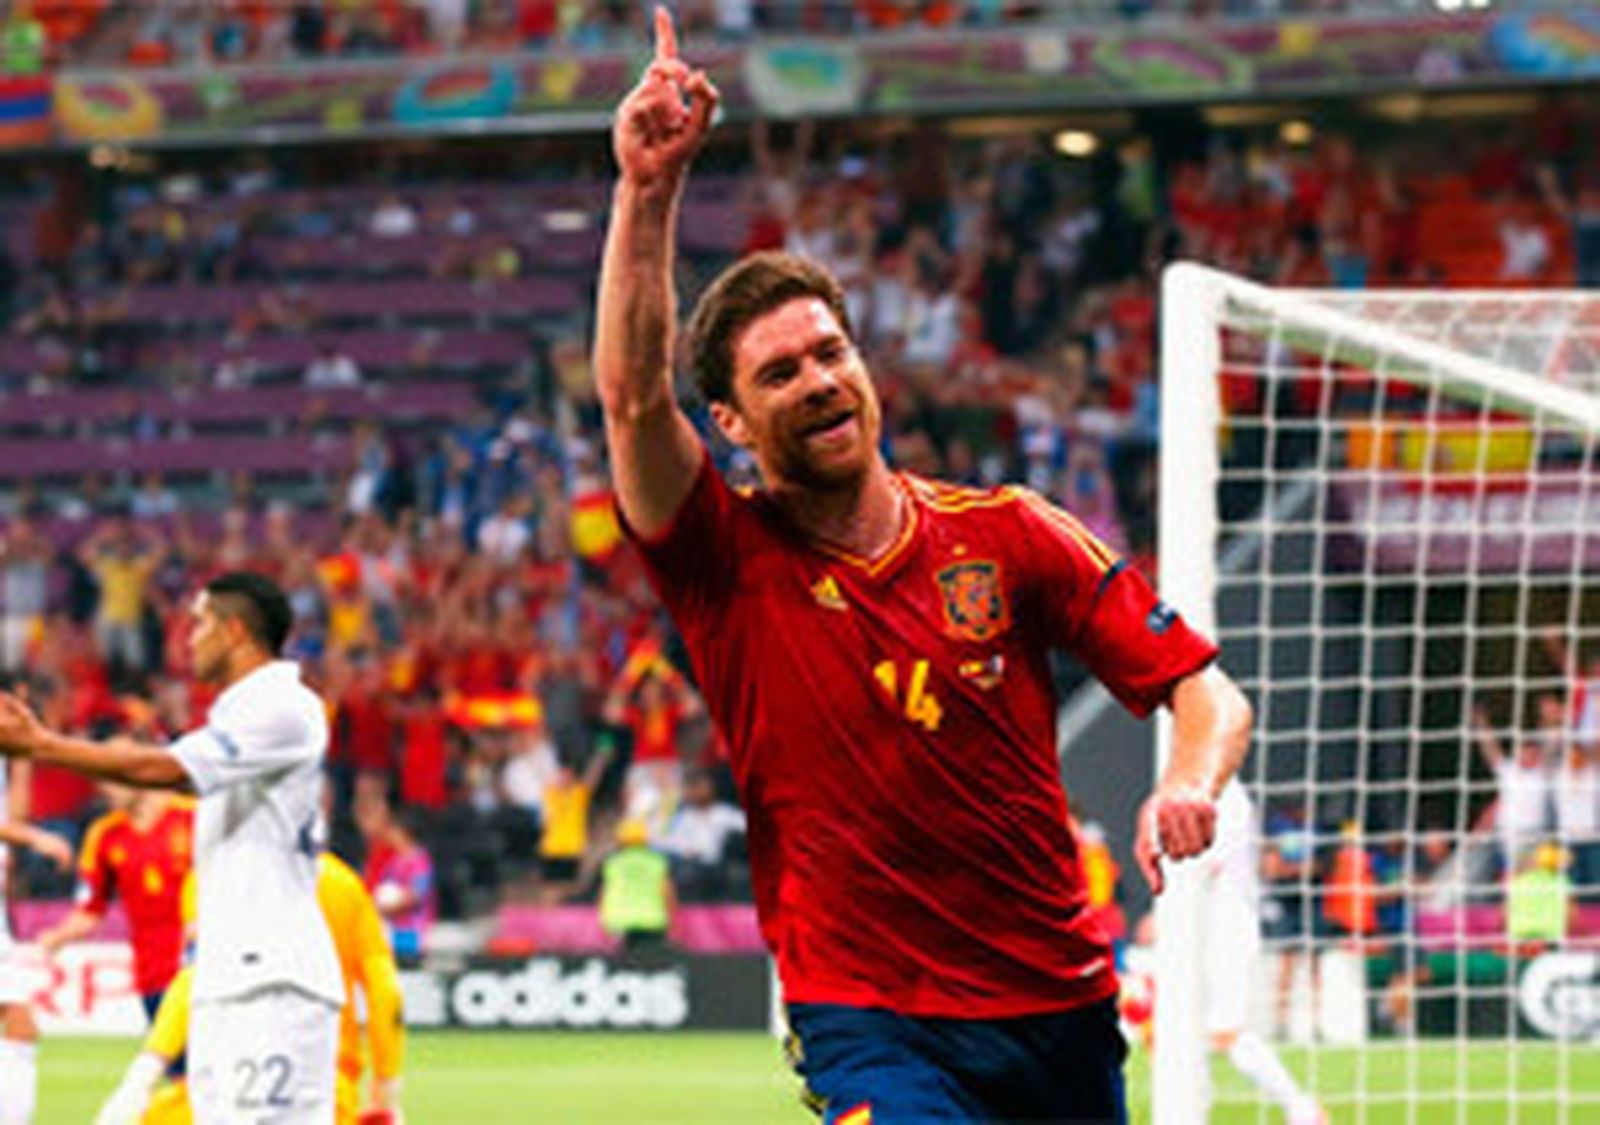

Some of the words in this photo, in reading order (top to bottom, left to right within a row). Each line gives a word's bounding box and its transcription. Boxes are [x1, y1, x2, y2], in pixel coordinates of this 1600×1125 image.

[873, 659, 943, 731] 14
[452, 958, 688, 1026] adidas
[234, 1055, 294, 1110] 22
